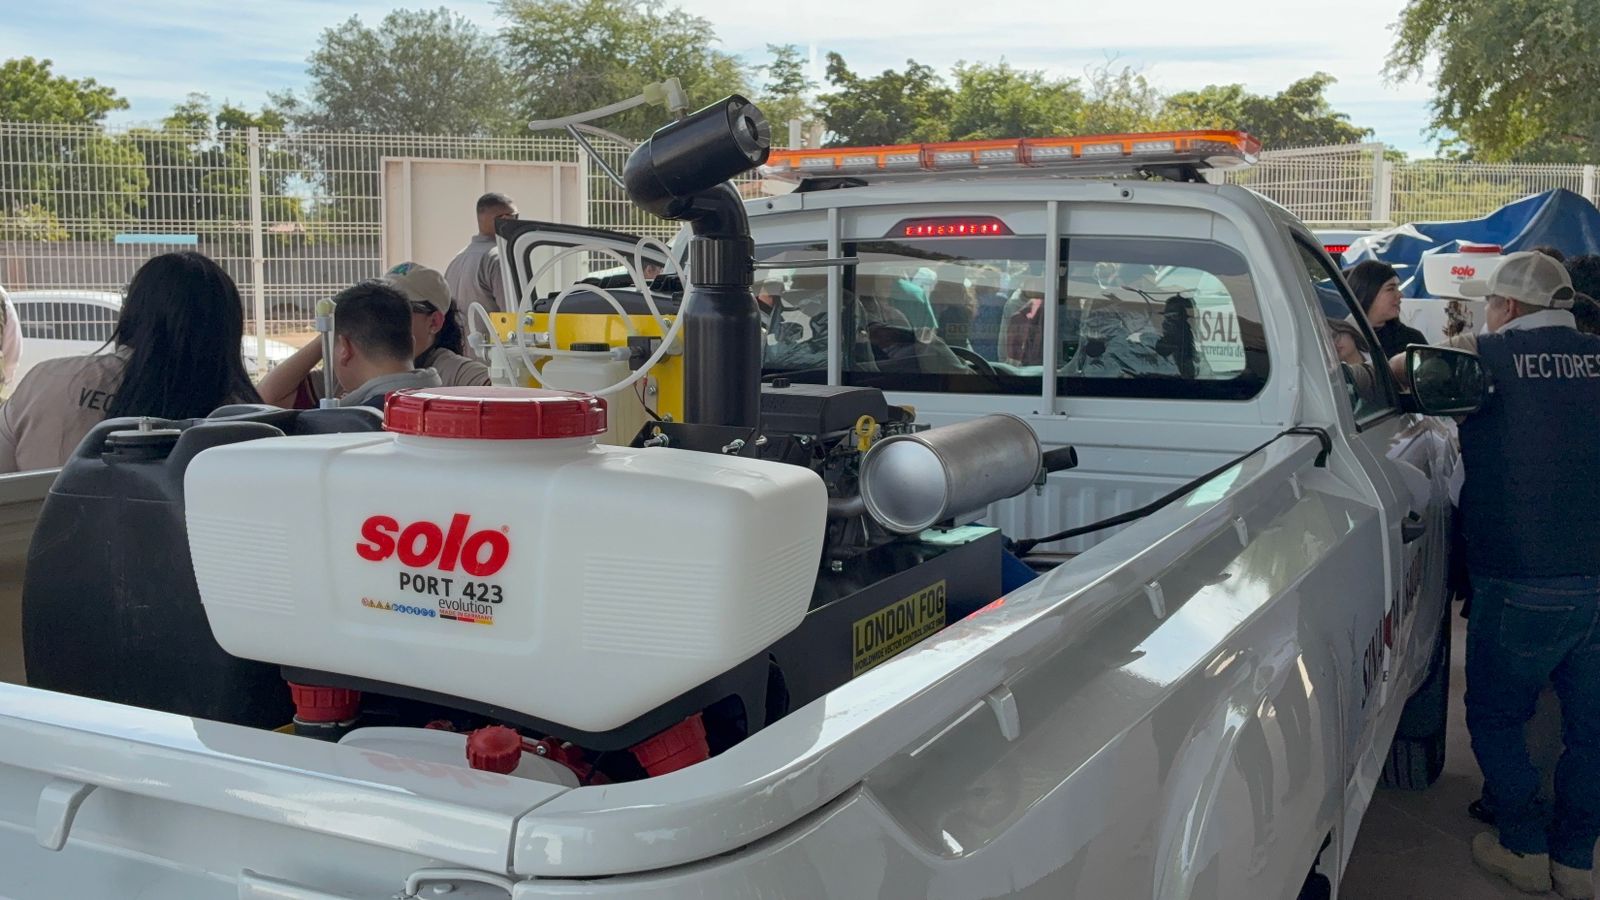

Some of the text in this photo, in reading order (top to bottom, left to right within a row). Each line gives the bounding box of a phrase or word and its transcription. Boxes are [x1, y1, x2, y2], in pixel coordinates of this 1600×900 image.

[1450, 264, 1475, 277] solo
[356, 512, 510, 577] solo
[400, 572, 504, 604] PORT 423
[438, 598, 493, 616] evolution
[855, 585, 944, 658] LONDON FOG
[855, 648, 884, 672] WORLDWIDE
[884, 637, 902, 656] VECTOR
[902, 628, 922, 647] CONTROL
